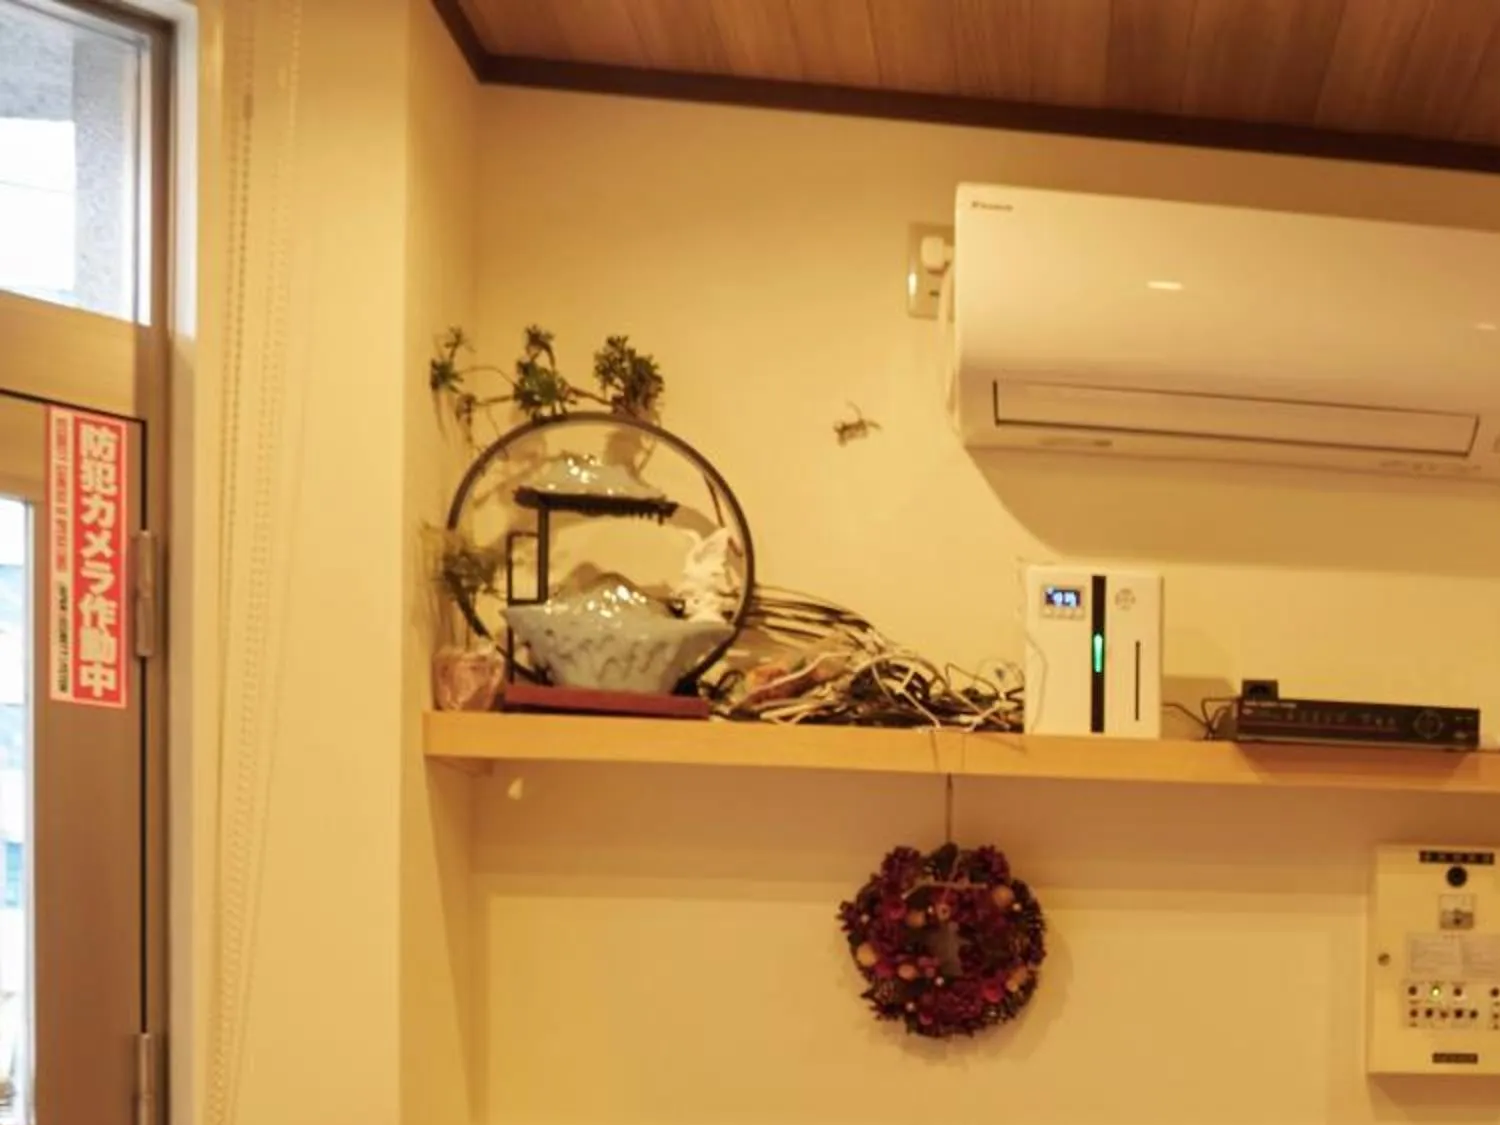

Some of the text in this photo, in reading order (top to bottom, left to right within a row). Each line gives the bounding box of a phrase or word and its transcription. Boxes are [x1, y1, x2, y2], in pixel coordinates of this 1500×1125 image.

[79, 422, 119, 698] 防犯カメラ作動中
